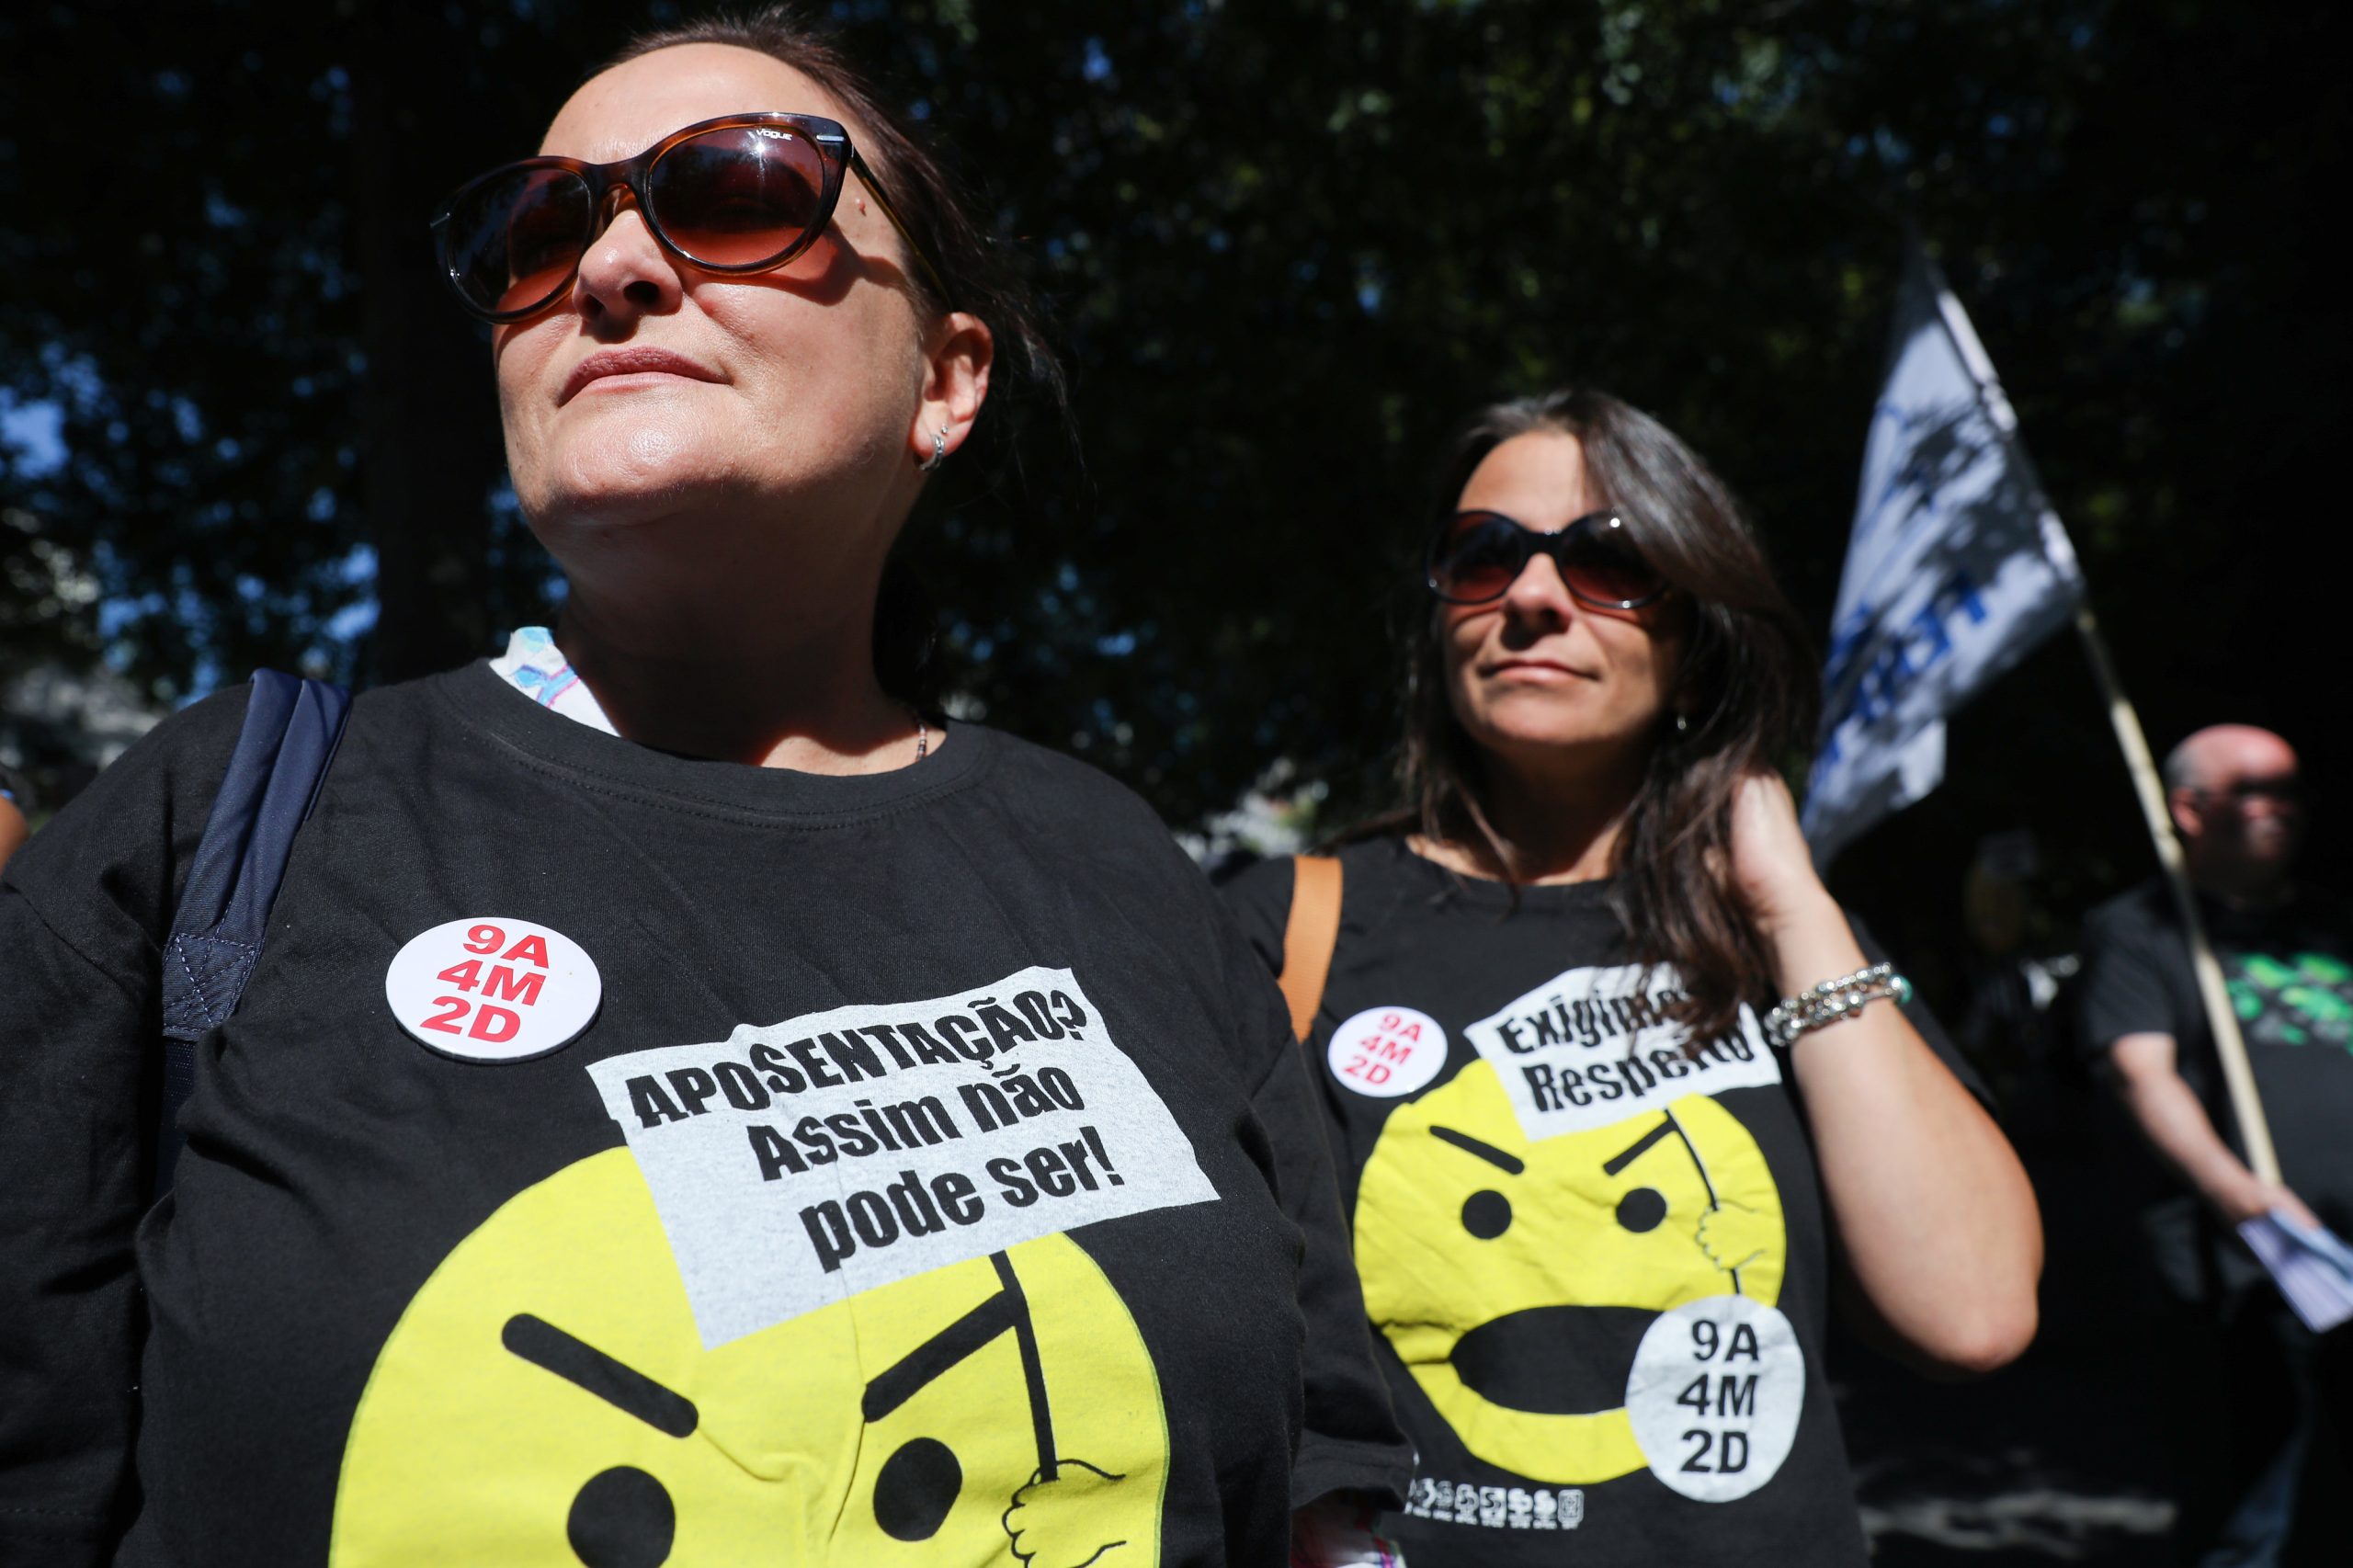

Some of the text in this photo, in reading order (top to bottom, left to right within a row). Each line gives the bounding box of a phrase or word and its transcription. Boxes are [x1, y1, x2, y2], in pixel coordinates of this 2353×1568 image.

[463, 925, 550, 969] 9A
[437, 960, 547, 1006] 4M
[420, 995, 521, 1042] 2D
[1380, 1014, 1421, 1042] 9A
[1495, 988, 1684, 1053] Exigim
[625, 990, 1087, 1130] APOSENTAÇÃO?
[1344, 1053, 1391, 1085] 2D
[1359, 1036, 1412, 1065] 4M
[746, 1063, 1086, 1182] Assim não
[798, 1124, 1126, 1274] pode ser!
[1691, 1319, 1759, 1361] 9A
[1676, 1373, 1759, 1416] 4M
[1679, 1429, 1748, 1473] 2D
